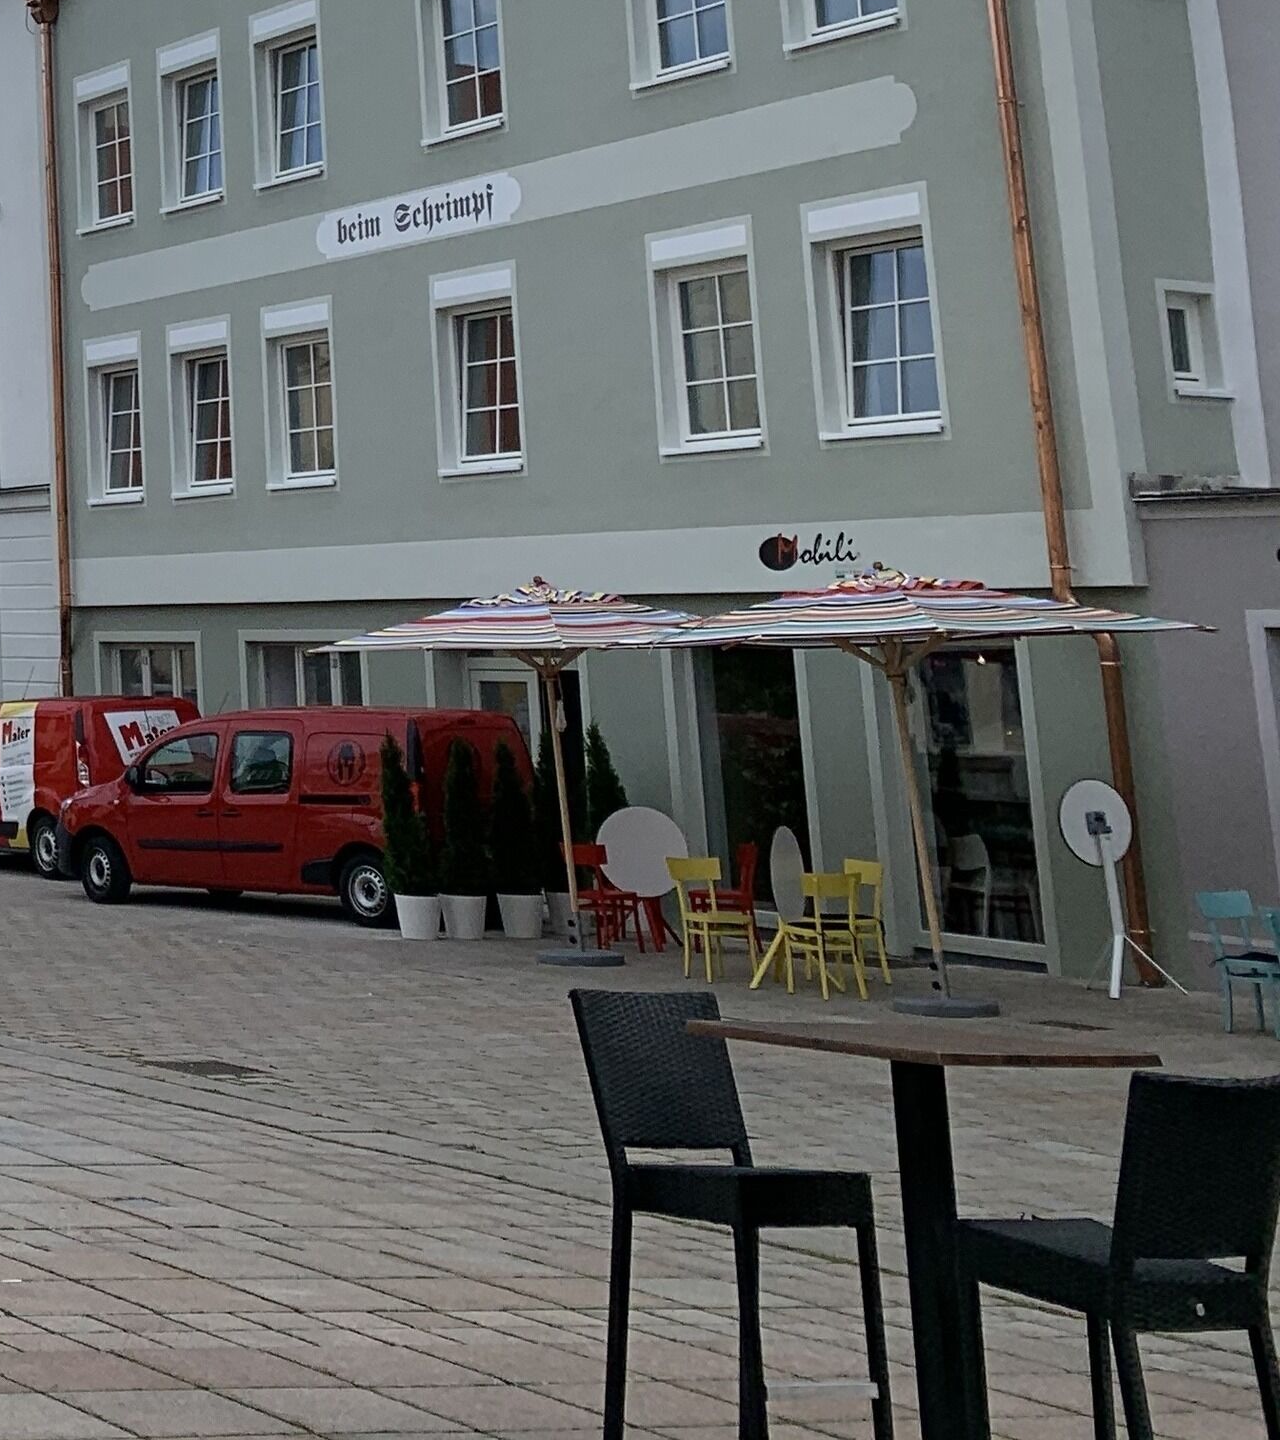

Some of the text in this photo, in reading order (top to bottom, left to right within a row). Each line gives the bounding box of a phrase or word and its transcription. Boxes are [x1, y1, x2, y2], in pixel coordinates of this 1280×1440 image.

[337, 182, 494, 245] beim Schrimpf
[776, 531, 858, 566] Mobili
[2, 720, 31, 746] Maier
